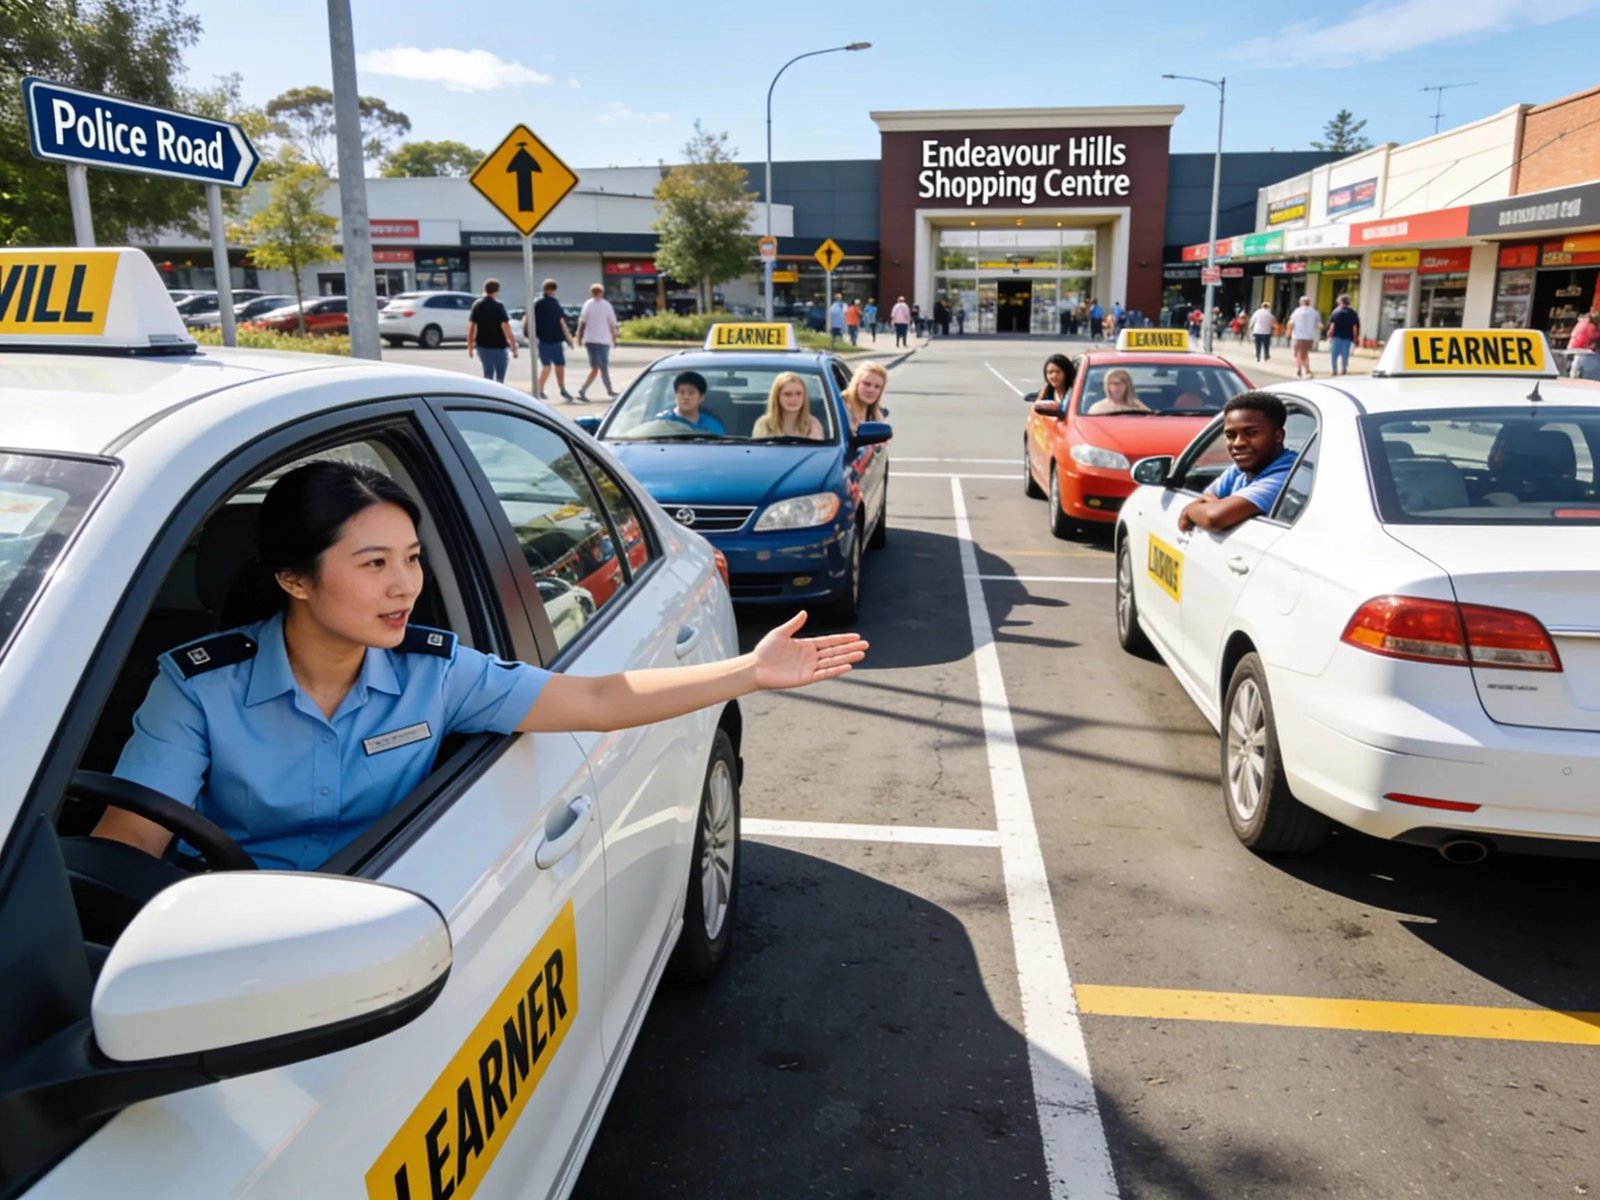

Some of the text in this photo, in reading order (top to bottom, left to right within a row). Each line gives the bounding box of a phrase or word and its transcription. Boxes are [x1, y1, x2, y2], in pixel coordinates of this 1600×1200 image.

[52, 98, 224, 171] Police Road
[923, 135, 1126, 167] Endeavour Hills
[918, 169, 1131, 206] Shopping Centre
[1412, 336, 1537, 366] LEARNER
